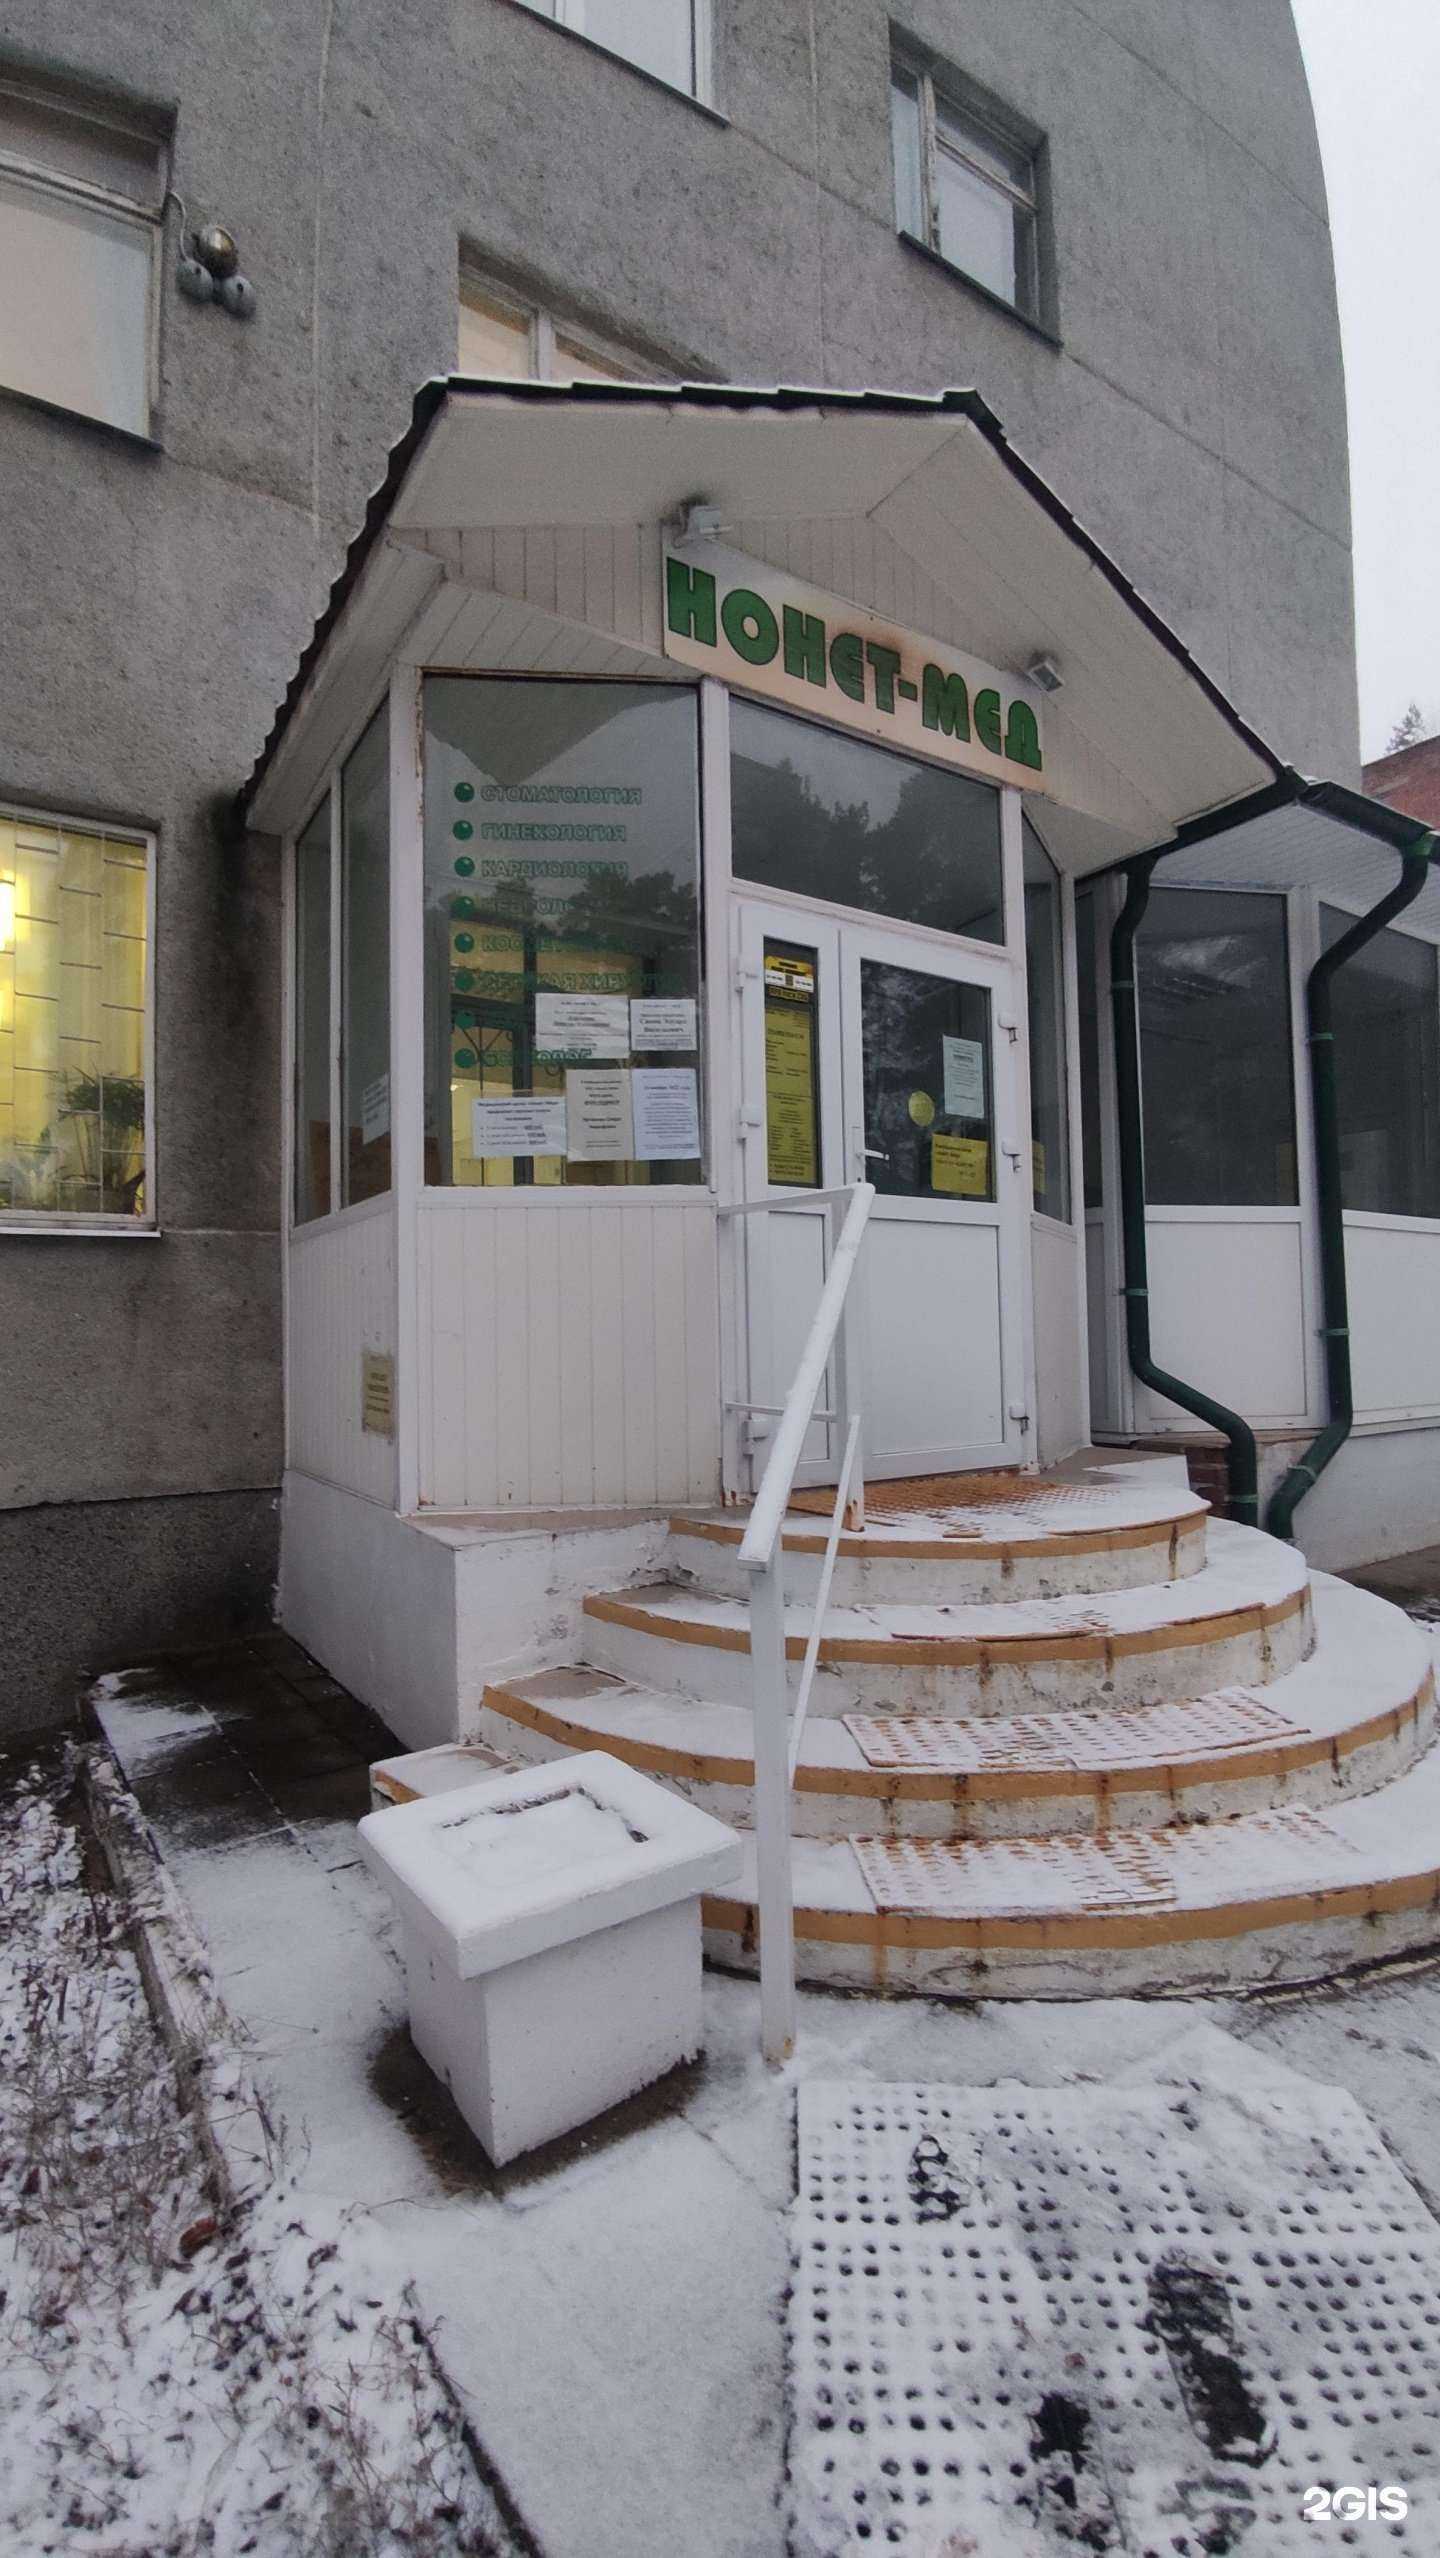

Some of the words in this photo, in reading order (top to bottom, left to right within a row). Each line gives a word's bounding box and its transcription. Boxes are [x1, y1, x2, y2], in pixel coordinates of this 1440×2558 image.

[666, 556, 1042, 772] НОНЕТ-МЕД
[480, 785, 642, 806] СТОМАТОЛОГИЯ
[480, 822, 626, 842] ГИНЕКОЛОГИЯ
[480, 859, 629, 879] КАРДИОЛОГИЯ
